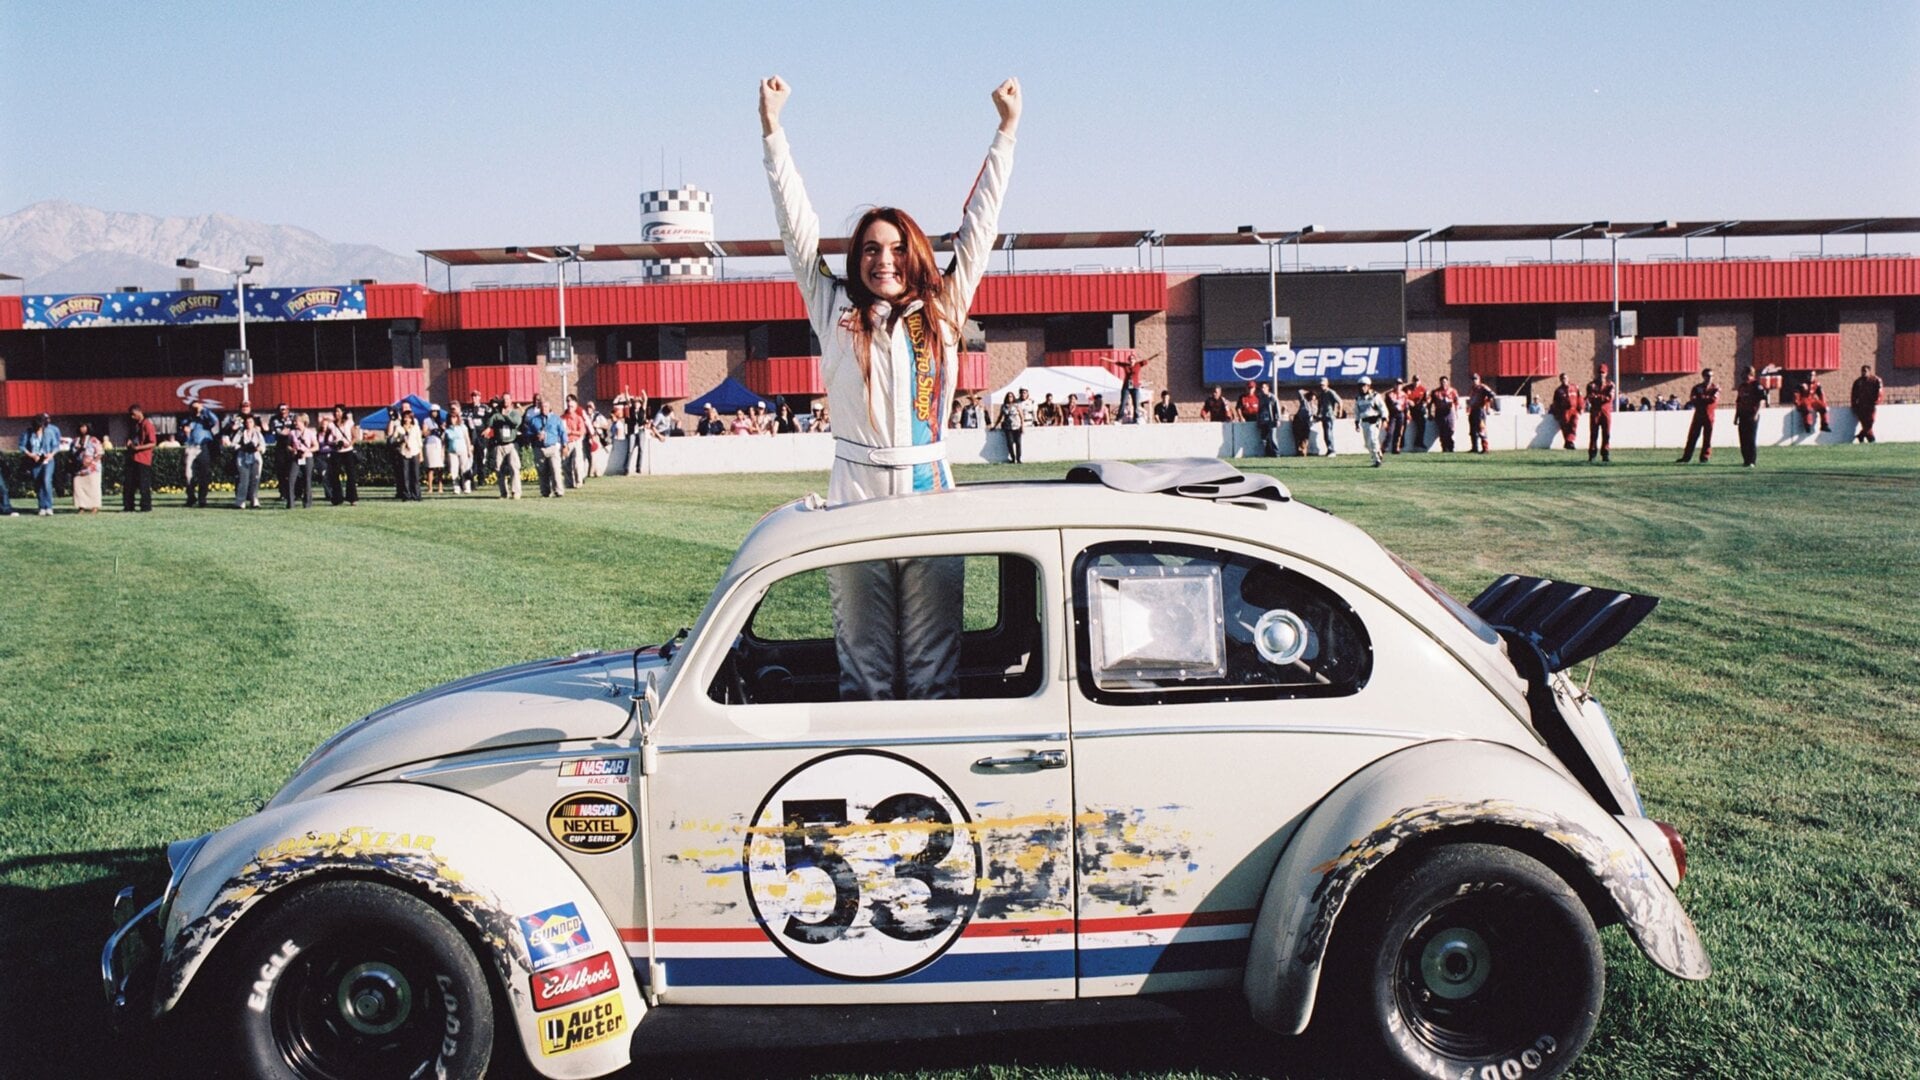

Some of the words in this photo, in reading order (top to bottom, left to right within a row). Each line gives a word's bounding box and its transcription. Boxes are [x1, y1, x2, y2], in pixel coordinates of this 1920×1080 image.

[1268, 347, 1380, 377] PEPSI
[915, 376, 934, 420] Shops
[580, 760, 625, 774] NASCAR
[580, 804, 617, 816] NASCAR
[563, 820, 618, 832] NEXTEL
[782, 793, 954, 944] 53
[533, 919, 580, 945] SUNOCO
[248, 939, 301, 1012] EAGLE
[541, 962, 611, 999] Edelbrock
[568, 1002, 612, 1028] Auto
[565, 1015, 622, 1050] Meter
